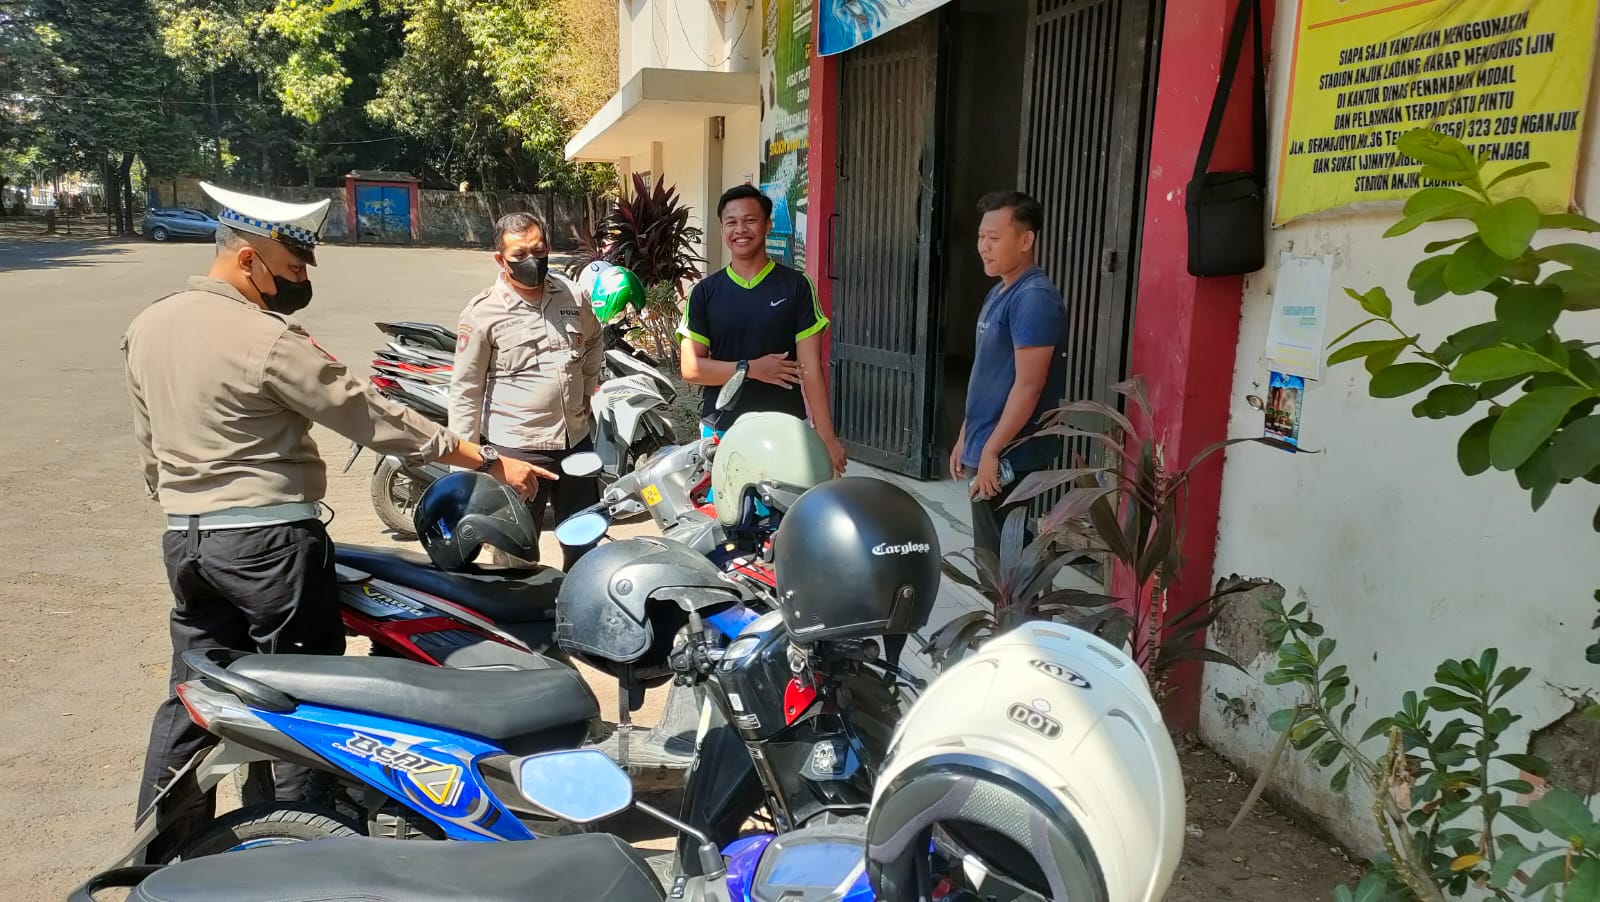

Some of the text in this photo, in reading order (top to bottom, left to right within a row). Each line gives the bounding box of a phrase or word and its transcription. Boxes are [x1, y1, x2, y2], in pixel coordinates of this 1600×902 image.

[1339, 10, 1530, 65] SIAPA SAJA YANG AKAN MENGGUNAKAN
[1319, 33, 1555, 90] STADION ANJUK LADANG HARAP MENGURUS IJIN
[1337, 65, 1516, 109] DI KANTOR DINAS PENANAMAN MODAL
[1334, 113, 1350, 130] DAN
[1353, 106, 1402, 128] PELAYANAN
[1448, 95, 1477, 115] SATU
[1478, 91, 1514, 112] PINTU
[1308, 135, 1356, 154] DERMOJOYO
[1468, 118, 1490, 137] 323
[1494, 116, 1518, 135] 209
[1520, 110, 1579, 134] NGANJUK
[1313, 158, 1329, 173] DAN
[1331, 155, 1357, 172] SURAT
[1358, 152, 1395, 170] IJINNYA
[1478, 141, 1530, 160] PENJAGA
[1354, 173, 1389, 192] STADION
[1391, 172, 1420, 189] ANJUK
[872, 541, 930, 556] Cargloss
[1031, 660, 1088, 688] KYT
[1012, 705, 1059, 735] DOT
